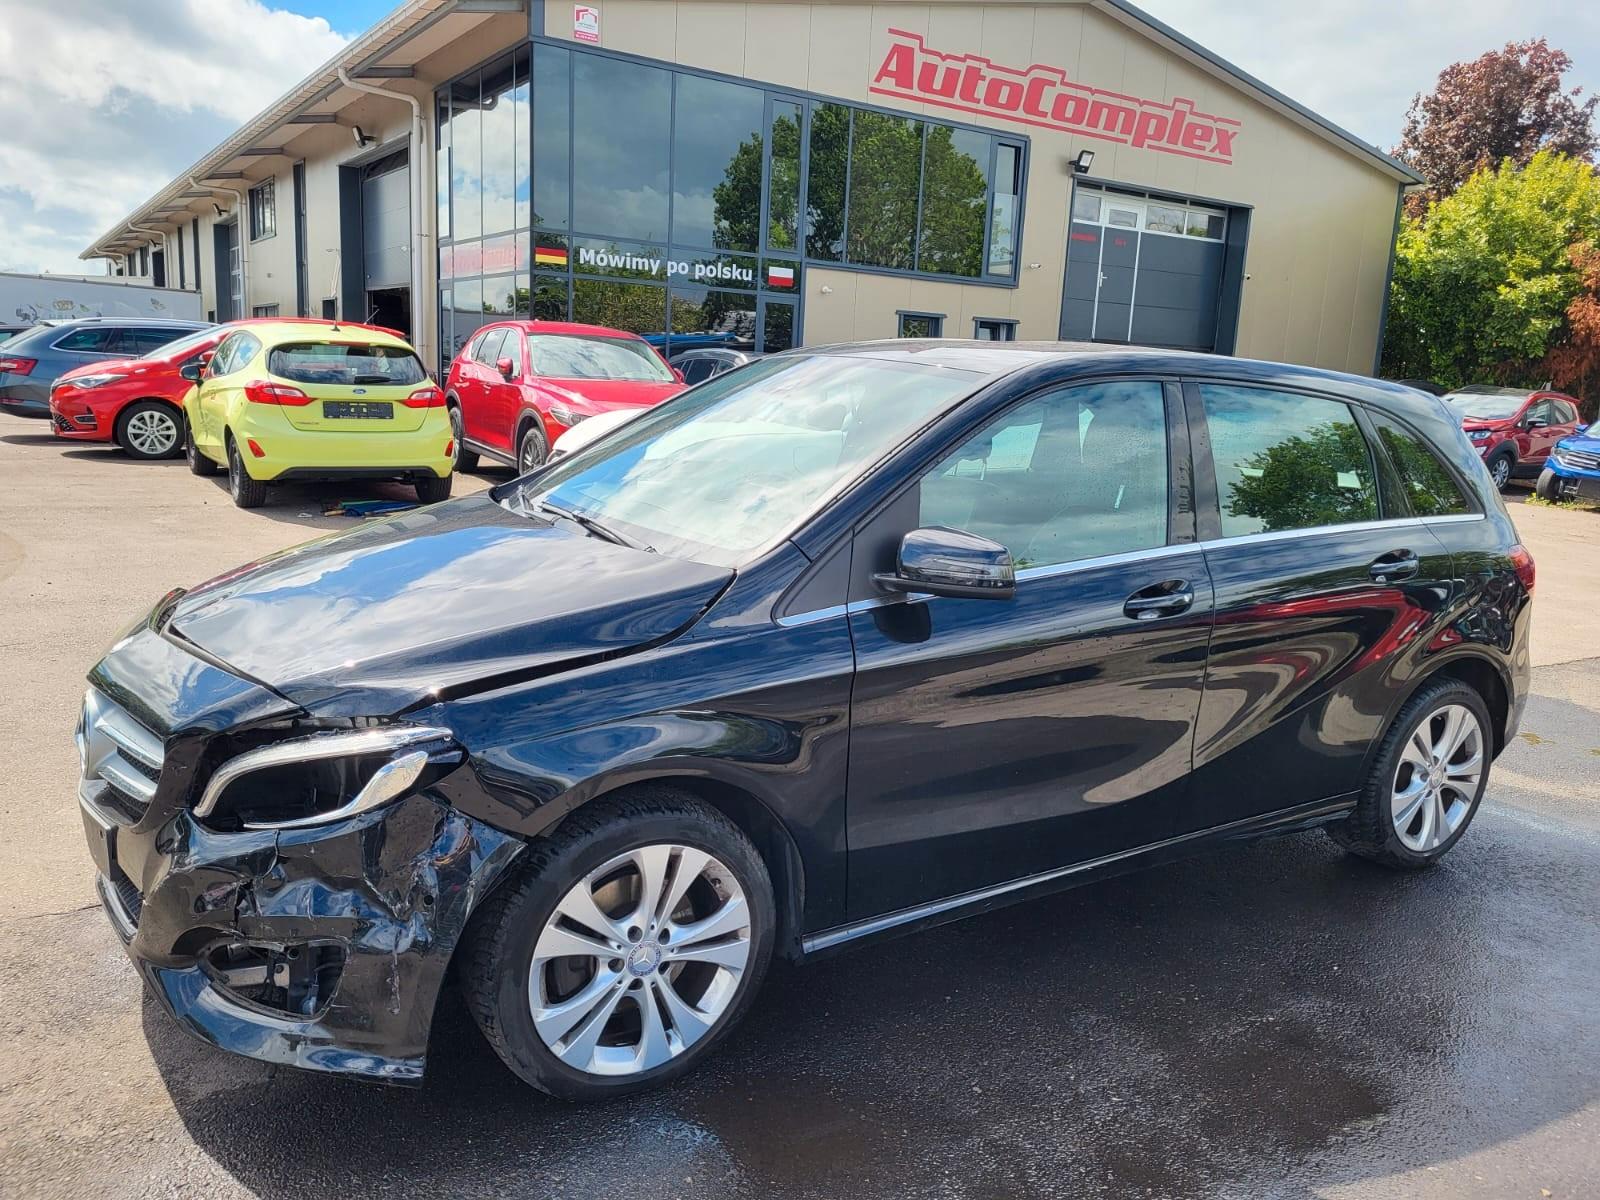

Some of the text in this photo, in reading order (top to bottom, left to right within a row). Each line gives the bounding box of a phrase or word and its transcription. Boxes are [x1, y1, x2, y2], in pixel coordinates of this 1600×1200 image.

[873, 43, 1238, 156] AutoComplex
[579, 248, 753, 281] Mówimy po polsku
